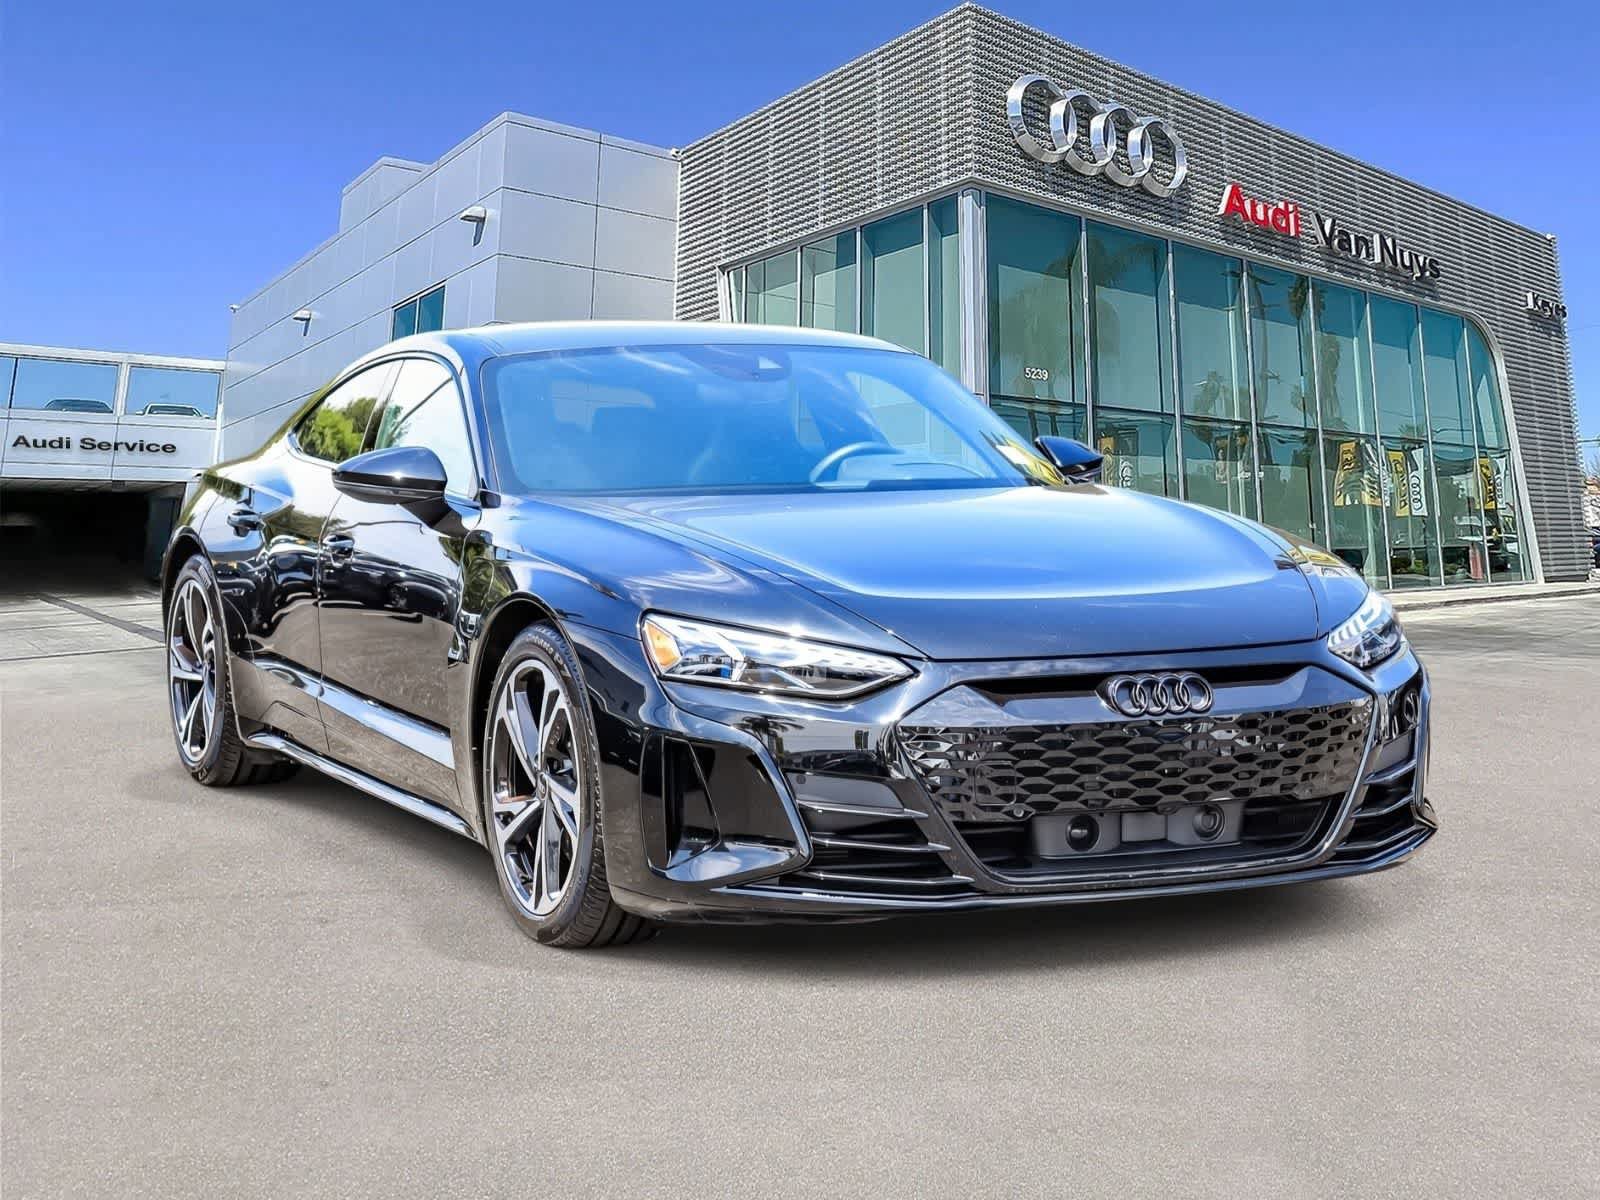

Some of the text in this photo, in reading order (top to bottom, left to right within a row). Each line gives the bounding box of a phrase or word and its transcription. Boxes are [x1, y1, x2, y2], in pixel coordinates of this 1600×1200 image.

[1218, 182, 1442, 281] Audi Van Nuys
[1527, 291, 1568, 318] Keyes
[1025, 367, 1049, 381] 5239
[12, 434, 177, 453] Audi Service
